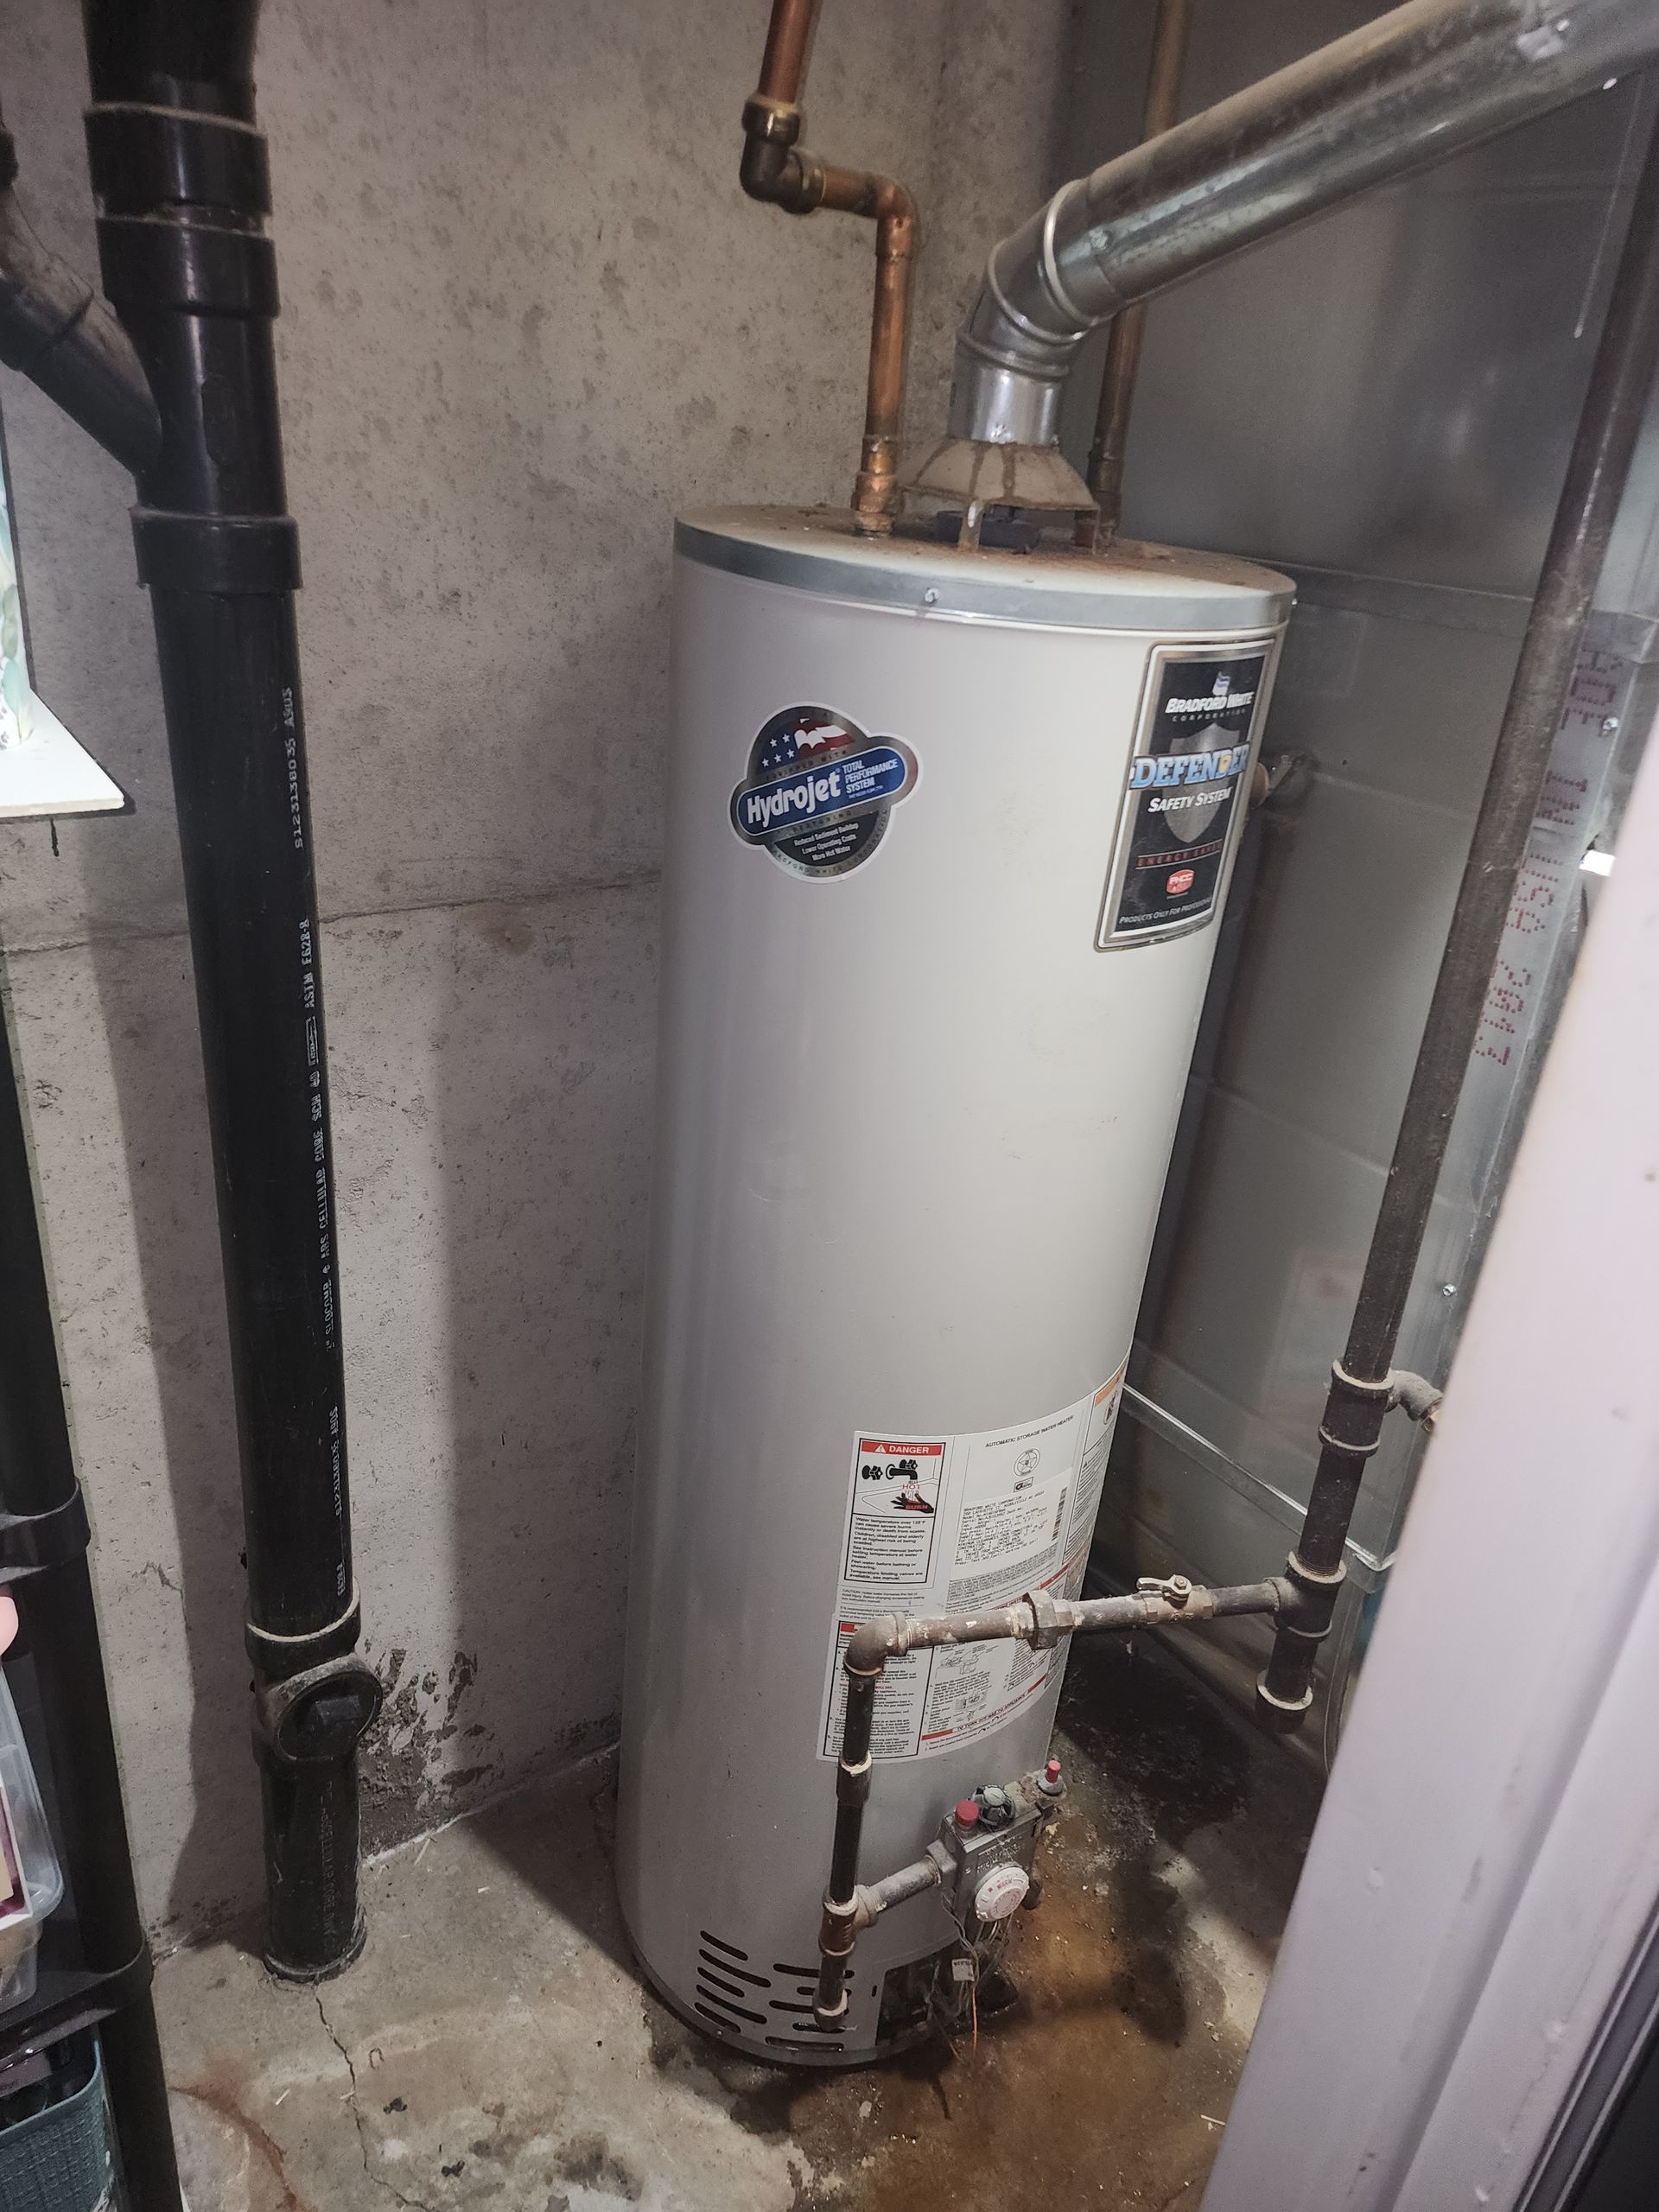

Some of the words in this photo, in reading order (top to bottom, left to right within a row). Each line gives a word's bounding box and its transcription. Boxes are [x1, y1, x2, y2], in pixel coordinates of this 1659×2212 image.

[1165, 697, 1228, 714] BRADFORD
[1226, 691, 1255, 709] WHITE
[842, 760, 865, 774] TOTAL
[845, 758, 899, 784] PERFORMANCE
[1131, 743, 1250, 789] DEFENDER
[846, 776, 875, 794] SYSTEM
[747, 772, 841, 828] Hydrojet
[1147, 794, 1194, 812] SAFETY
[1195, 787, 1232, 807] SYSTEM
[1119, 913, 1153, 925] PRODUCTS
[1169, 907, 1181, 916] FOR
[303, 970, 316, 1009] ASTM
[985, 1438, 1015, 1447] AUTOMATIC
[1017, 1430, 1040, 1441] STORAGE
[1041, 1424, 1057, 1433] WATER
[1057, 1415, 1073, 1426] HEATER
